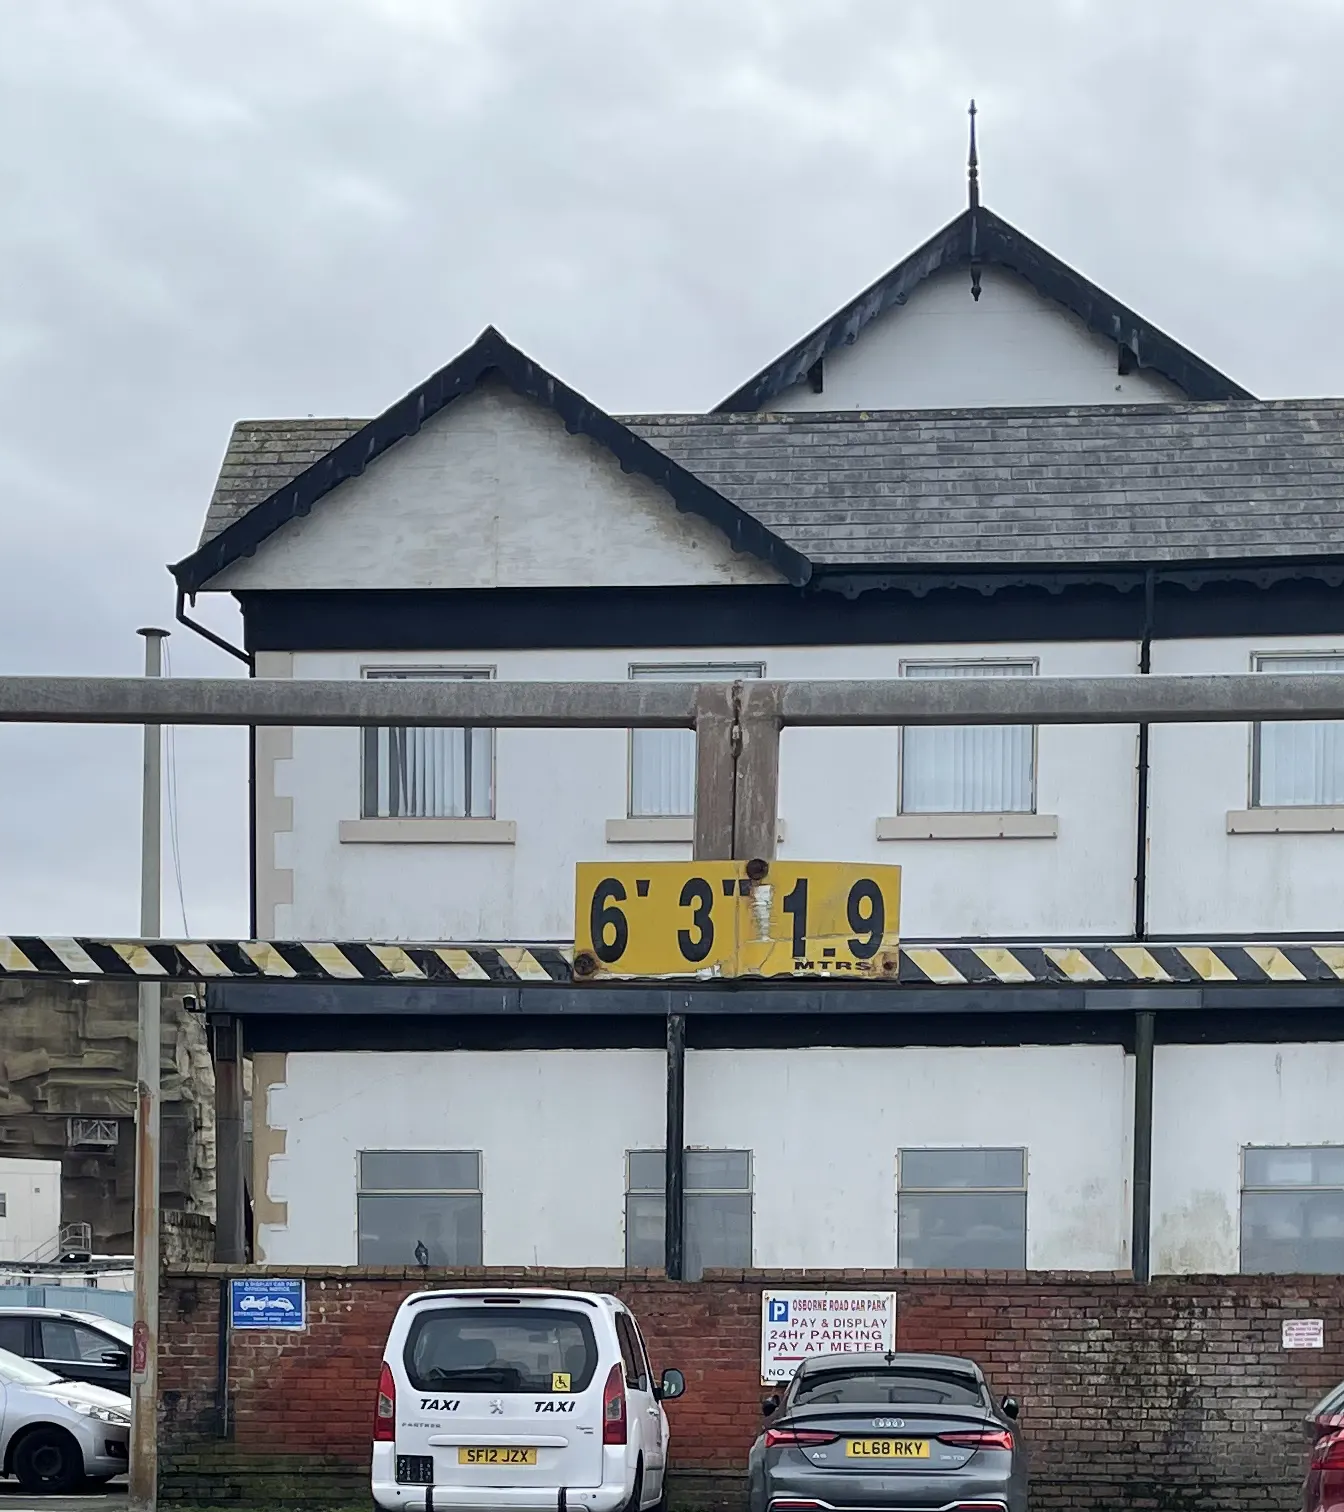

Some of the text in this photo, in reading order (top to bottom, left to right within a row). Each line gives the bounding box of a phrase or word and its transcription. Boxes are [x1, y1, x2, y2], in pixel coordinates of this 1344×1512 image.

[794, 960, 872, 971] MTRS
[774, 1302, 785, 1320] P
[792, 1300, 887, 1312] OSBORNE ROAD CAR PARK
[791, 1318, 888, 1328] PAY & DISPLAY
[770, 1330, 882, 1340] 24Hr PARKING
[768, 1342, 884, 1351] PAY AT METER
[768, 1368, 785, 1376] NO
[420, 1399, 460, 1411] TAXI
[534, 1401, 575, 1412] TAXI
[852, 1441, 923, 1456] CL68 RKY
[467, 1449, 528, 1463] SF12 JZX
